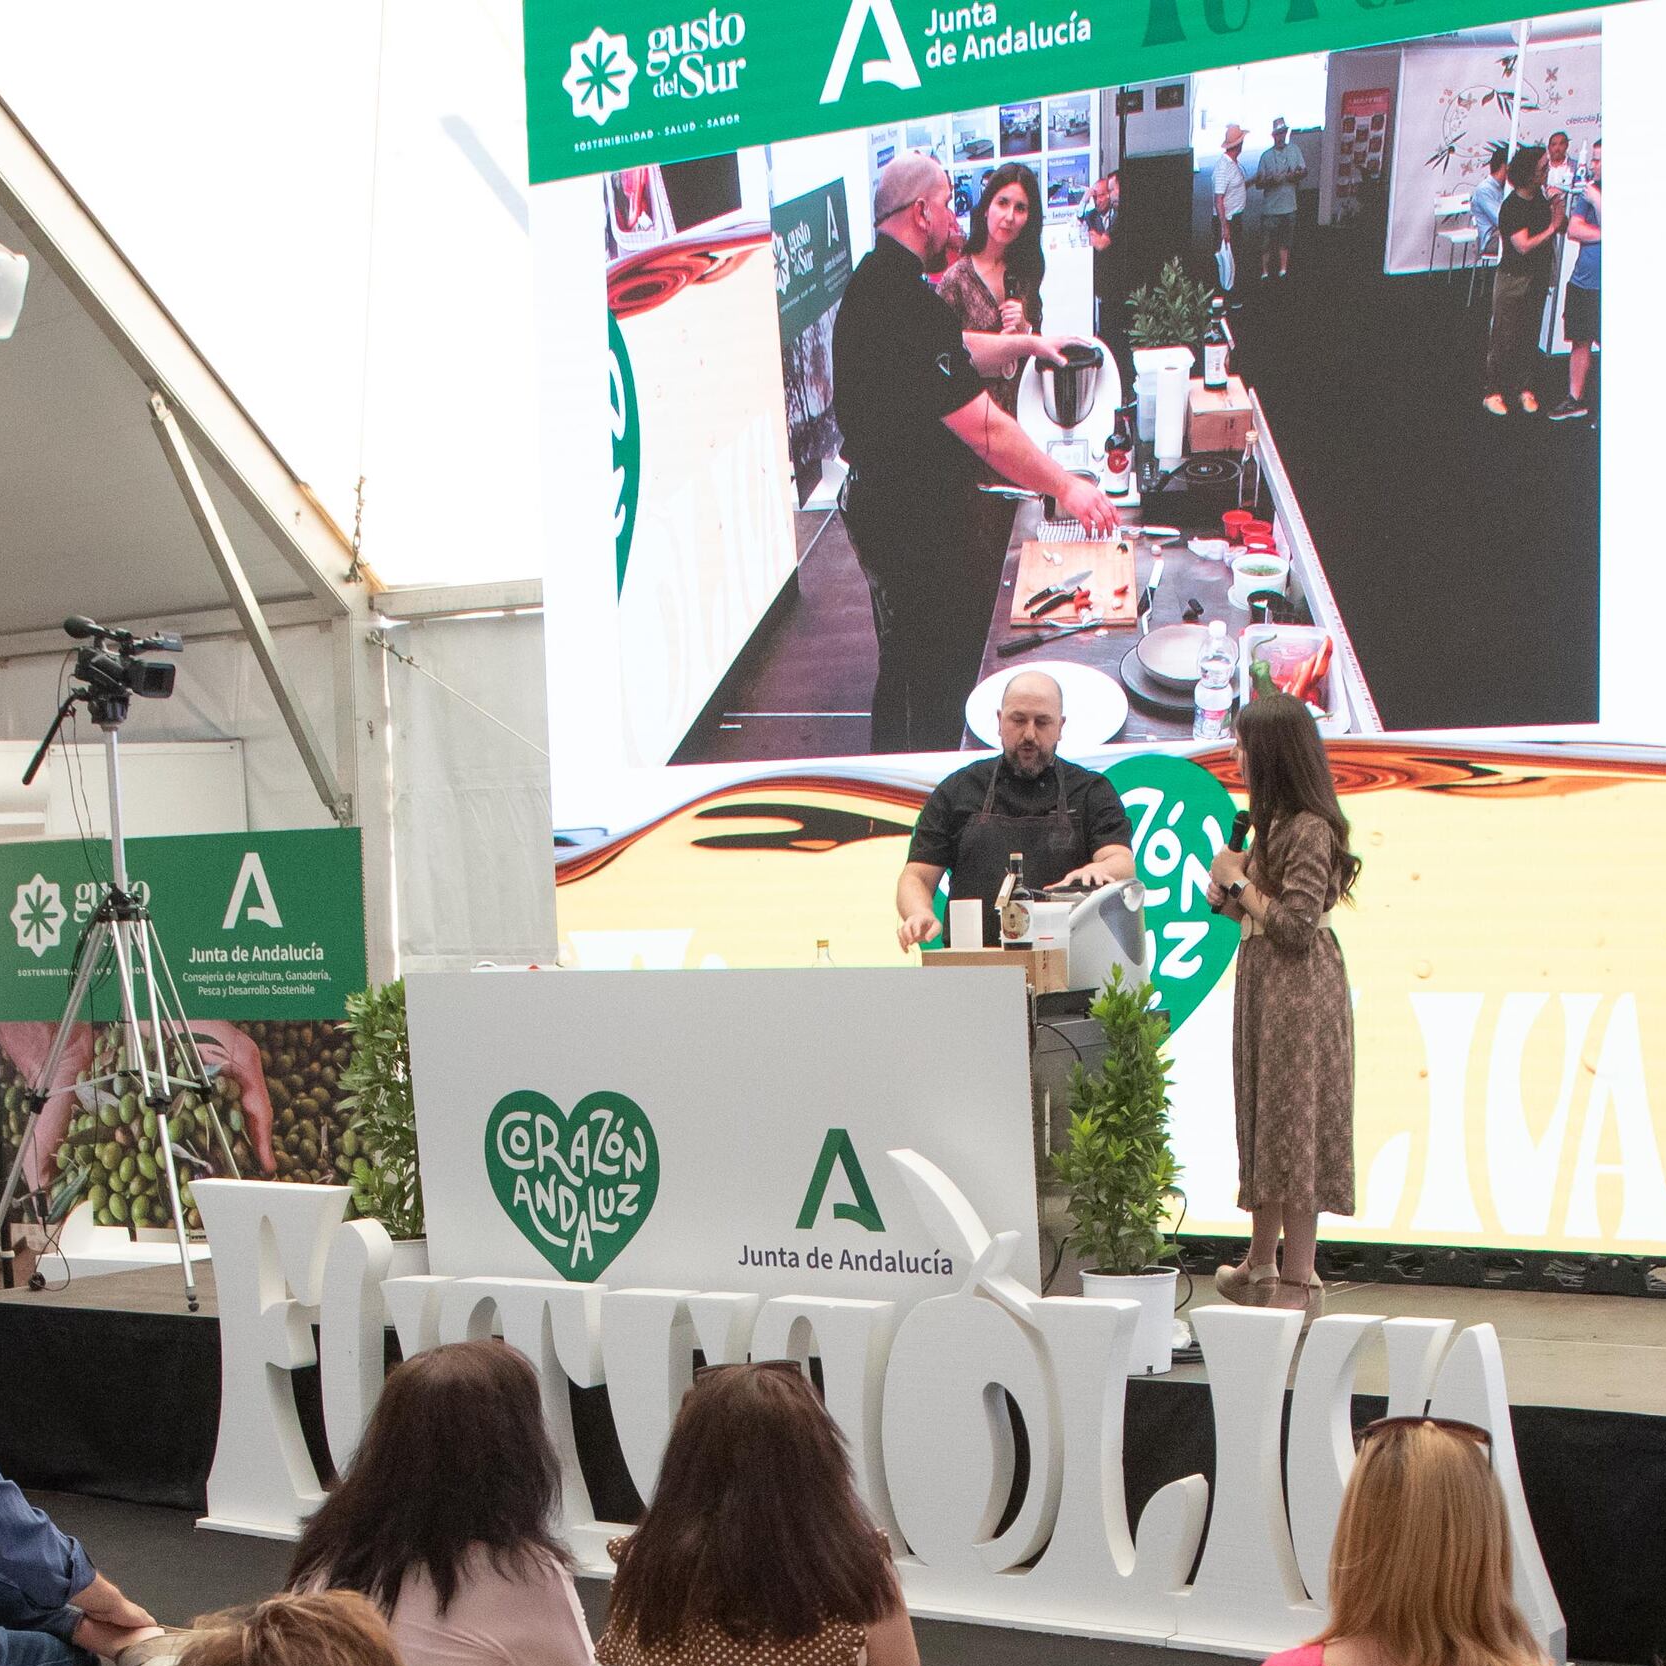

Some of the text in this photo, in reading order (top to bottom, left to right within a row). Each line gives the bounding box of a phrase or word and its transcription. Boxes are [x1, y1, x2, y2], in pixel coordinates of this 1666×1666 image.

[925, 2, 998, 36] Junta
[646, 7, 746, 77] gusto
[925, 15, 1092, 68] de Andalucía
[653, 53, 747, 99] del Sur
[574, 113, 741, 152] SOSTENIBILIDAD SALUD SABOR
[189, 942, 324, 963] Junta de Andalucía
[183, 968, 332, 984] Consejería de Agricultura, Ganadería,
[198, 983, 315, 998] Pesca y Desarrollo Sostenible
[497, 1109, 647, 1187] CORAZÓN
[514, 1174, 641, 1268] ANDALUZ
[738, 1245, 954, 1275] Junta de Andalucía
